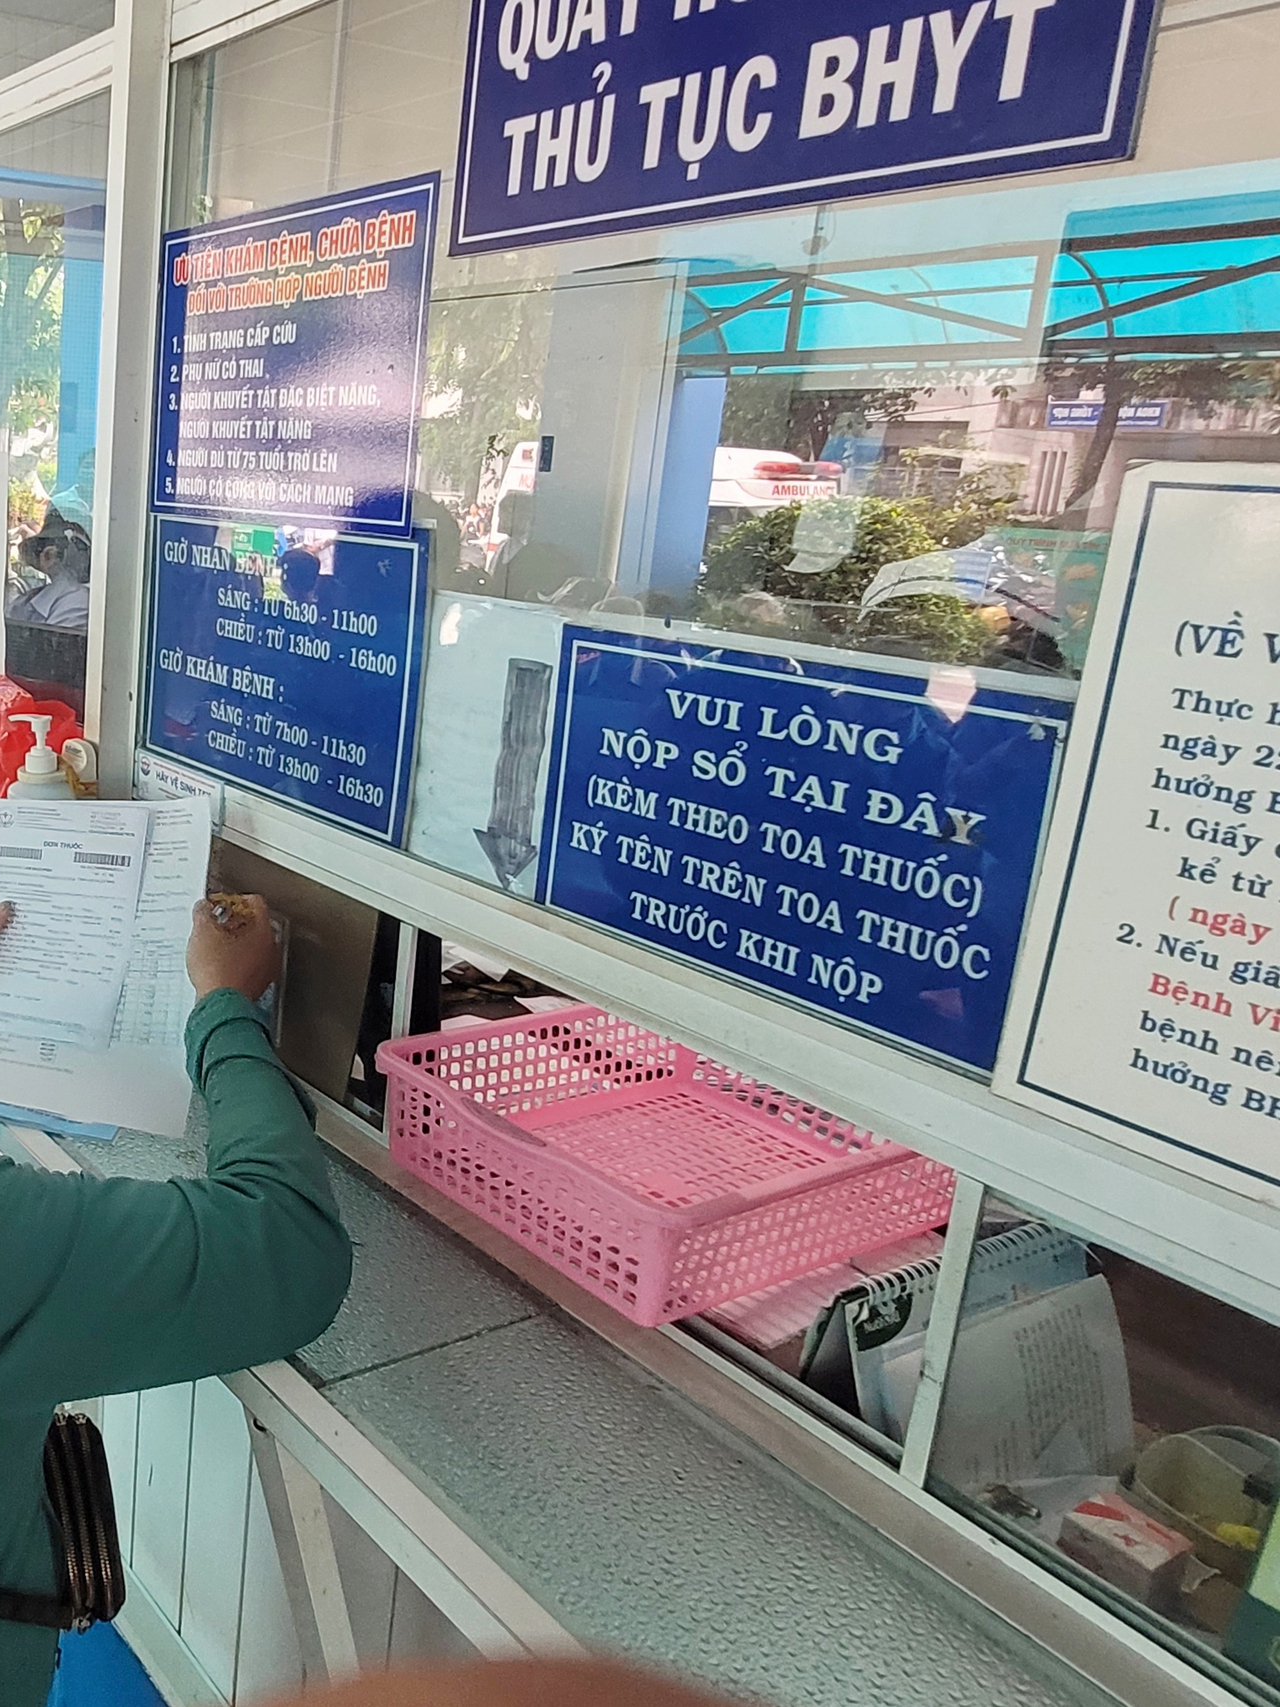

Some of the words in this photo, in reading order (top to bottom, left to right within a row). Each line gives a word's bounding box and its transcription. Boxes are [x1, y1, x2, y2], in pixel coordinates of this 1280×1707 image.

[503, 60, 616, 197] THỦ
[639, 54, 778, 181] TỤC
[798, 0, 1057, 141] BHYT
[191, 245, 222, 282] TIÊN
[224, 237, 266, 278] KHÁM
[269, 230, 314, 274] BỆNH,
[317, 216, 361, 260] CHỮA
[364, 209, 417, 259] BỆNH
[275, 272, 302, 308] HỢP
[348, 257, 389, 299] BỆNH
[172, 336, 181, 354] 1.
[209, 330, 244, 355] TRẠNG
[246, 322, 268, 348] CẤP
[272, 320, 297, 345] CỨU
[170, 365, 180, 383] 2.
[182, 363, 202, 385] PHỤ
[238, 358, 264, 379] THAI
[169, 393, 178, 411] 3.
[256, 383, 277, 412] TẬT
[279, 384, 303, 413] ĐẶC
[306, 381, 335, 412] BIỆT
[255, 416, 275, 443] TẬT
[277, 418, 313, 444] NẶNG
[166, 450, 175, 467] 4.
[242, 451, 256, 470] 75
[258, 445, 284, 471] TUỔI
[312, 450, 338, 472] LÊN
[165, 478, 174, 494] 5.
[314, 485, 354, 509] MẠNG
[163, 537, 188, 564] GIỜ
[217, 586, 251, 612] SÁNG
[283, 599, 318, 624] 6h30
[331, 608, 378, 638] 11h00
[1175, 610, 1245, 657] (VỀ
[216, 612, 254, 645] CHIỀU
[266, 626, 285, 651] TỪ
[288, 634, 331, 662] 13h00
[349, 648, 397, 678] 16h00
[159, 647, 183, 673] GIỜ
[185, 653, 229, 689] KHÁM
[231, 665, 276, 701] BỆNH
[665, 686, 742, 732] VUI
[759, 704, 905, 765] LÒNG
[1171, 688, 1254, 722] Thực
[210, 698, 243, 728] SÁNG
[253, 710, 273, 734] TỪ
[274, 718, 309, 748] 7h00
[321, 735, 367, 767] 11h30
[1159, 732, 1242, 766] ngày
[180, 781, 196, 796] SINH
[207, 728, 247, 760] CHIỀU
[256, 743, 275, 768] TỪ
[278, 753, 319, 785] 13h00
[338, 775, 384, 808] 16h30
[599, 726, 680, 773] NỘP
[691, 740, 748, 788] SỔ
[763, 764, 848, 816] TẠI
[864, 788, 989, 846] ĐÂY
[1150, 767, 1257, 815] hưởng
[586, 773, 658, 820] (KÈM
[666, 794, 749, 846] THEO
[759, 822, 827, 869] TOA
[838, 840, 985, 917] THUỐC)
[1145, 809, 1171, 833] 1.
[1185, 817, 1264, 857] Giấy
[568, 819, 609, 856] KÝ
[616, 831, 672, 878] TÊN
[680, 852, 768, 908] TRÊN
[776, 884, 844, 934] TOA
[855, 909, 993, 981] THUỐC
[1176, 855, 1221, 884] kể
[1231, 870, 1273, 899] từ
[628, 887, 730, 950] TRƯỚC
[735, 927, 801, 977] KHI
[809, 953, 885, 1006] NỘP
[1116, 922, 1143, 948] 2.
[1154, 933, 1220, 971] Nếu
[1188, 906, 1272, 946] ngày
[1147, 972, 1233, 1018] Bệnh
[1139, 1010, 1219, 1055] bệnh
[1230, 1044, 1280, 1076] nê
[1129, 1048, 1231, 1107] hưởng
